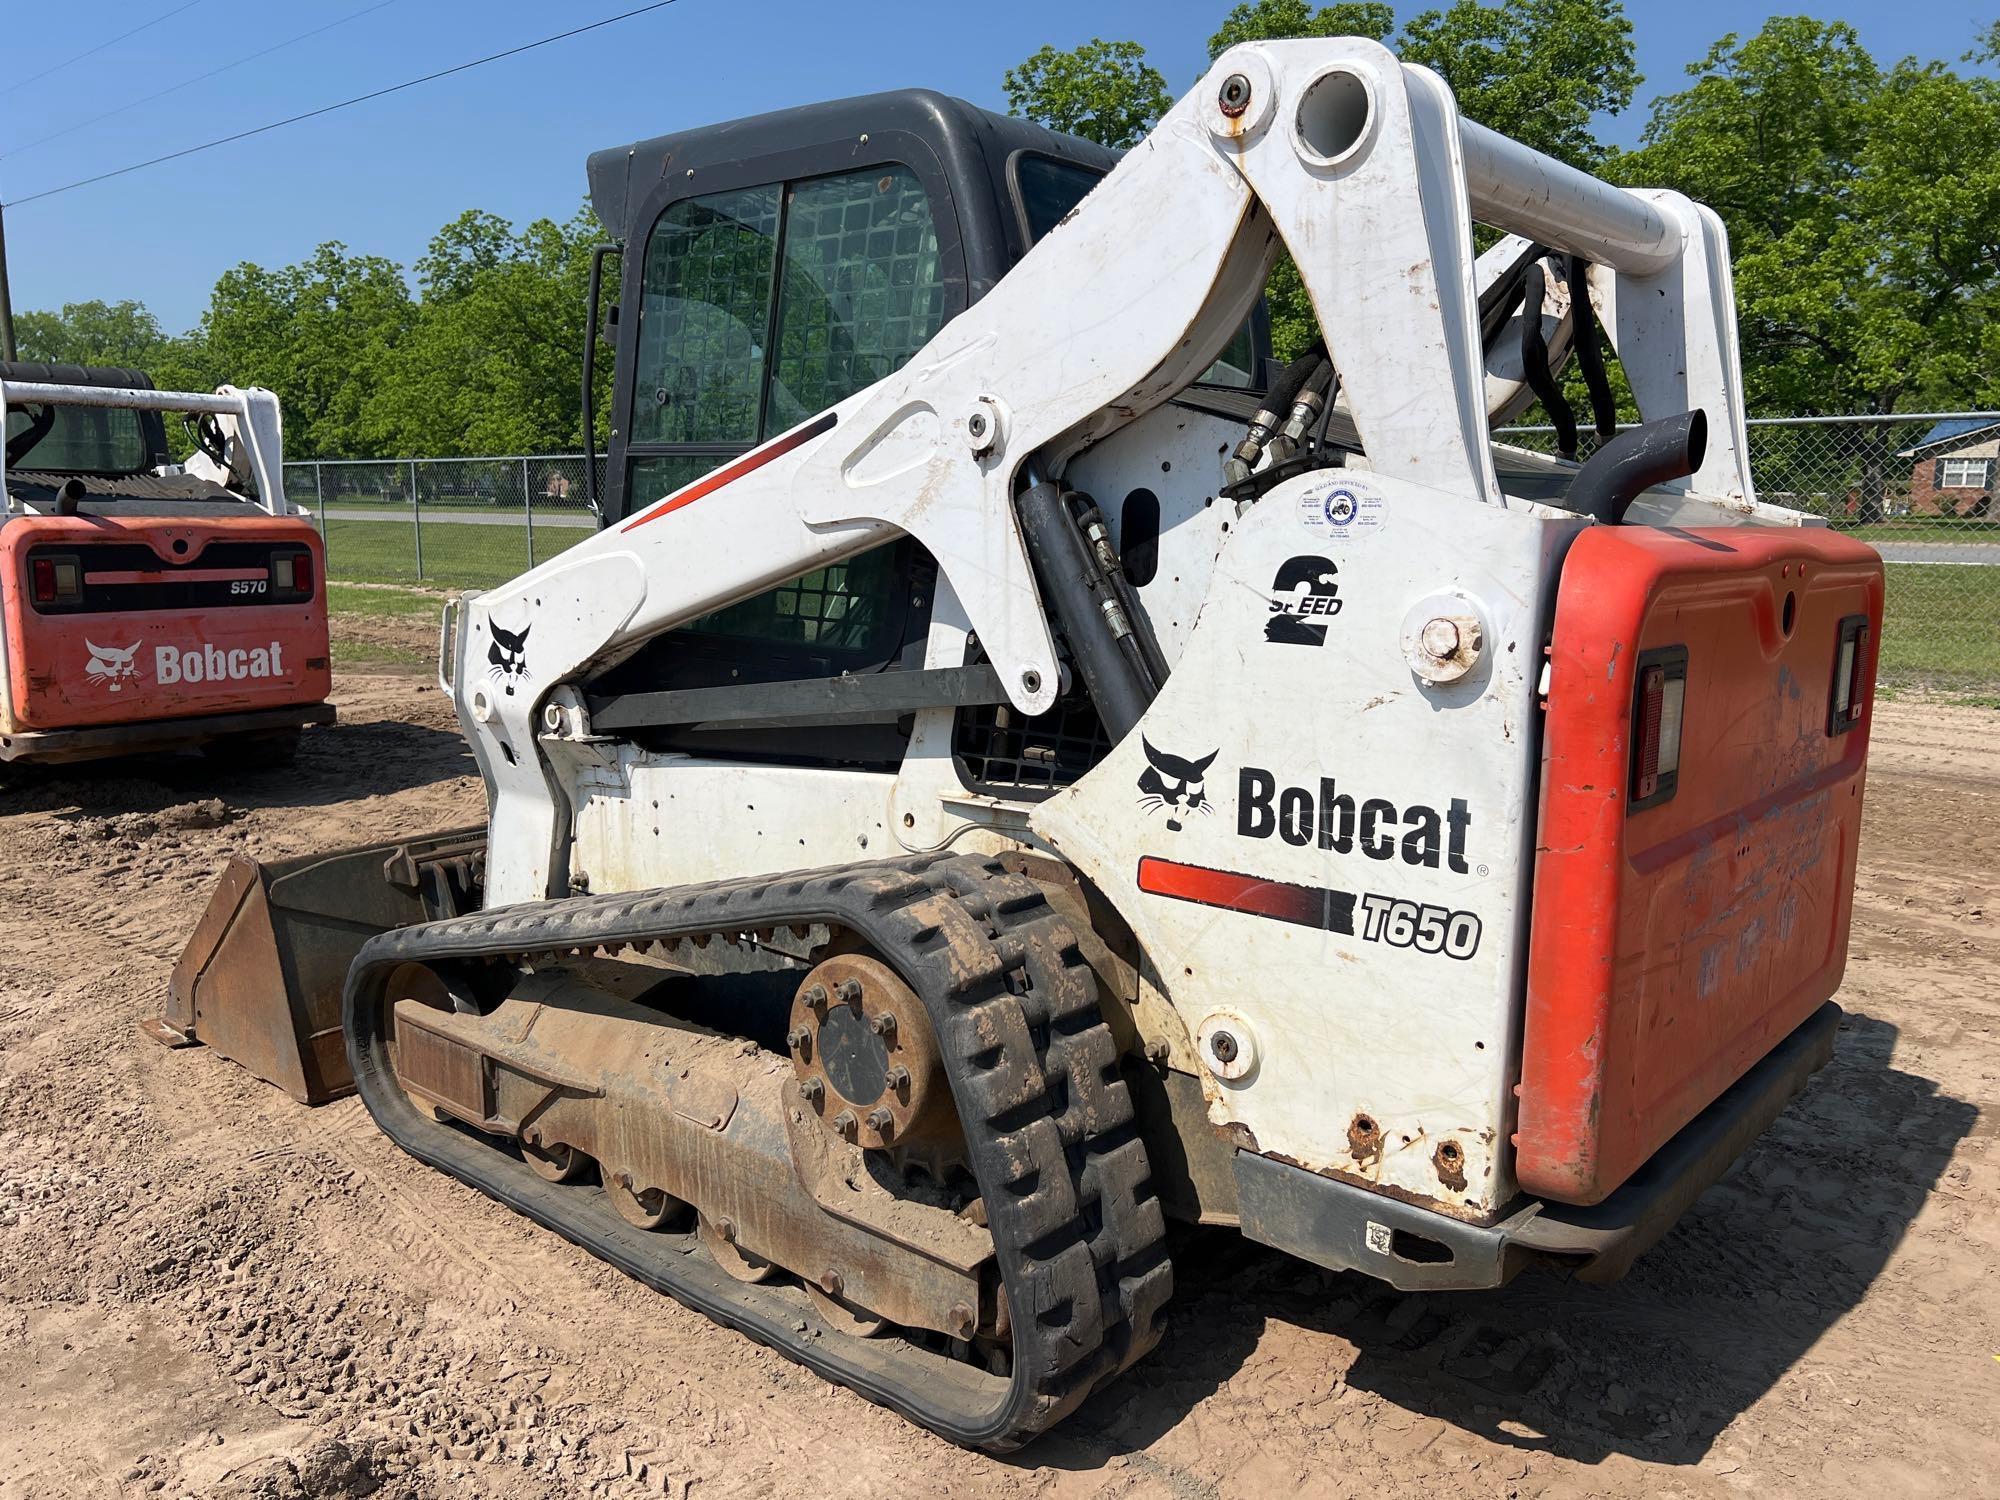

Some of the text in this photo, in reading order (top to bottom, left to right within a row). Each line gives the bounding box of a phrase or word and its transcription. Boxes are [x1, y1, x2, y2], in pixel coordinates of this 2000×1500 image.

[230, 580, 267, 595] S570
[1264, 555, 1338, 647] 2
[155, 641, 283, 685] Bobcat
[1237, 767, 1471, 875] Bobcat
[1362, 893, 1483, 960] T650
